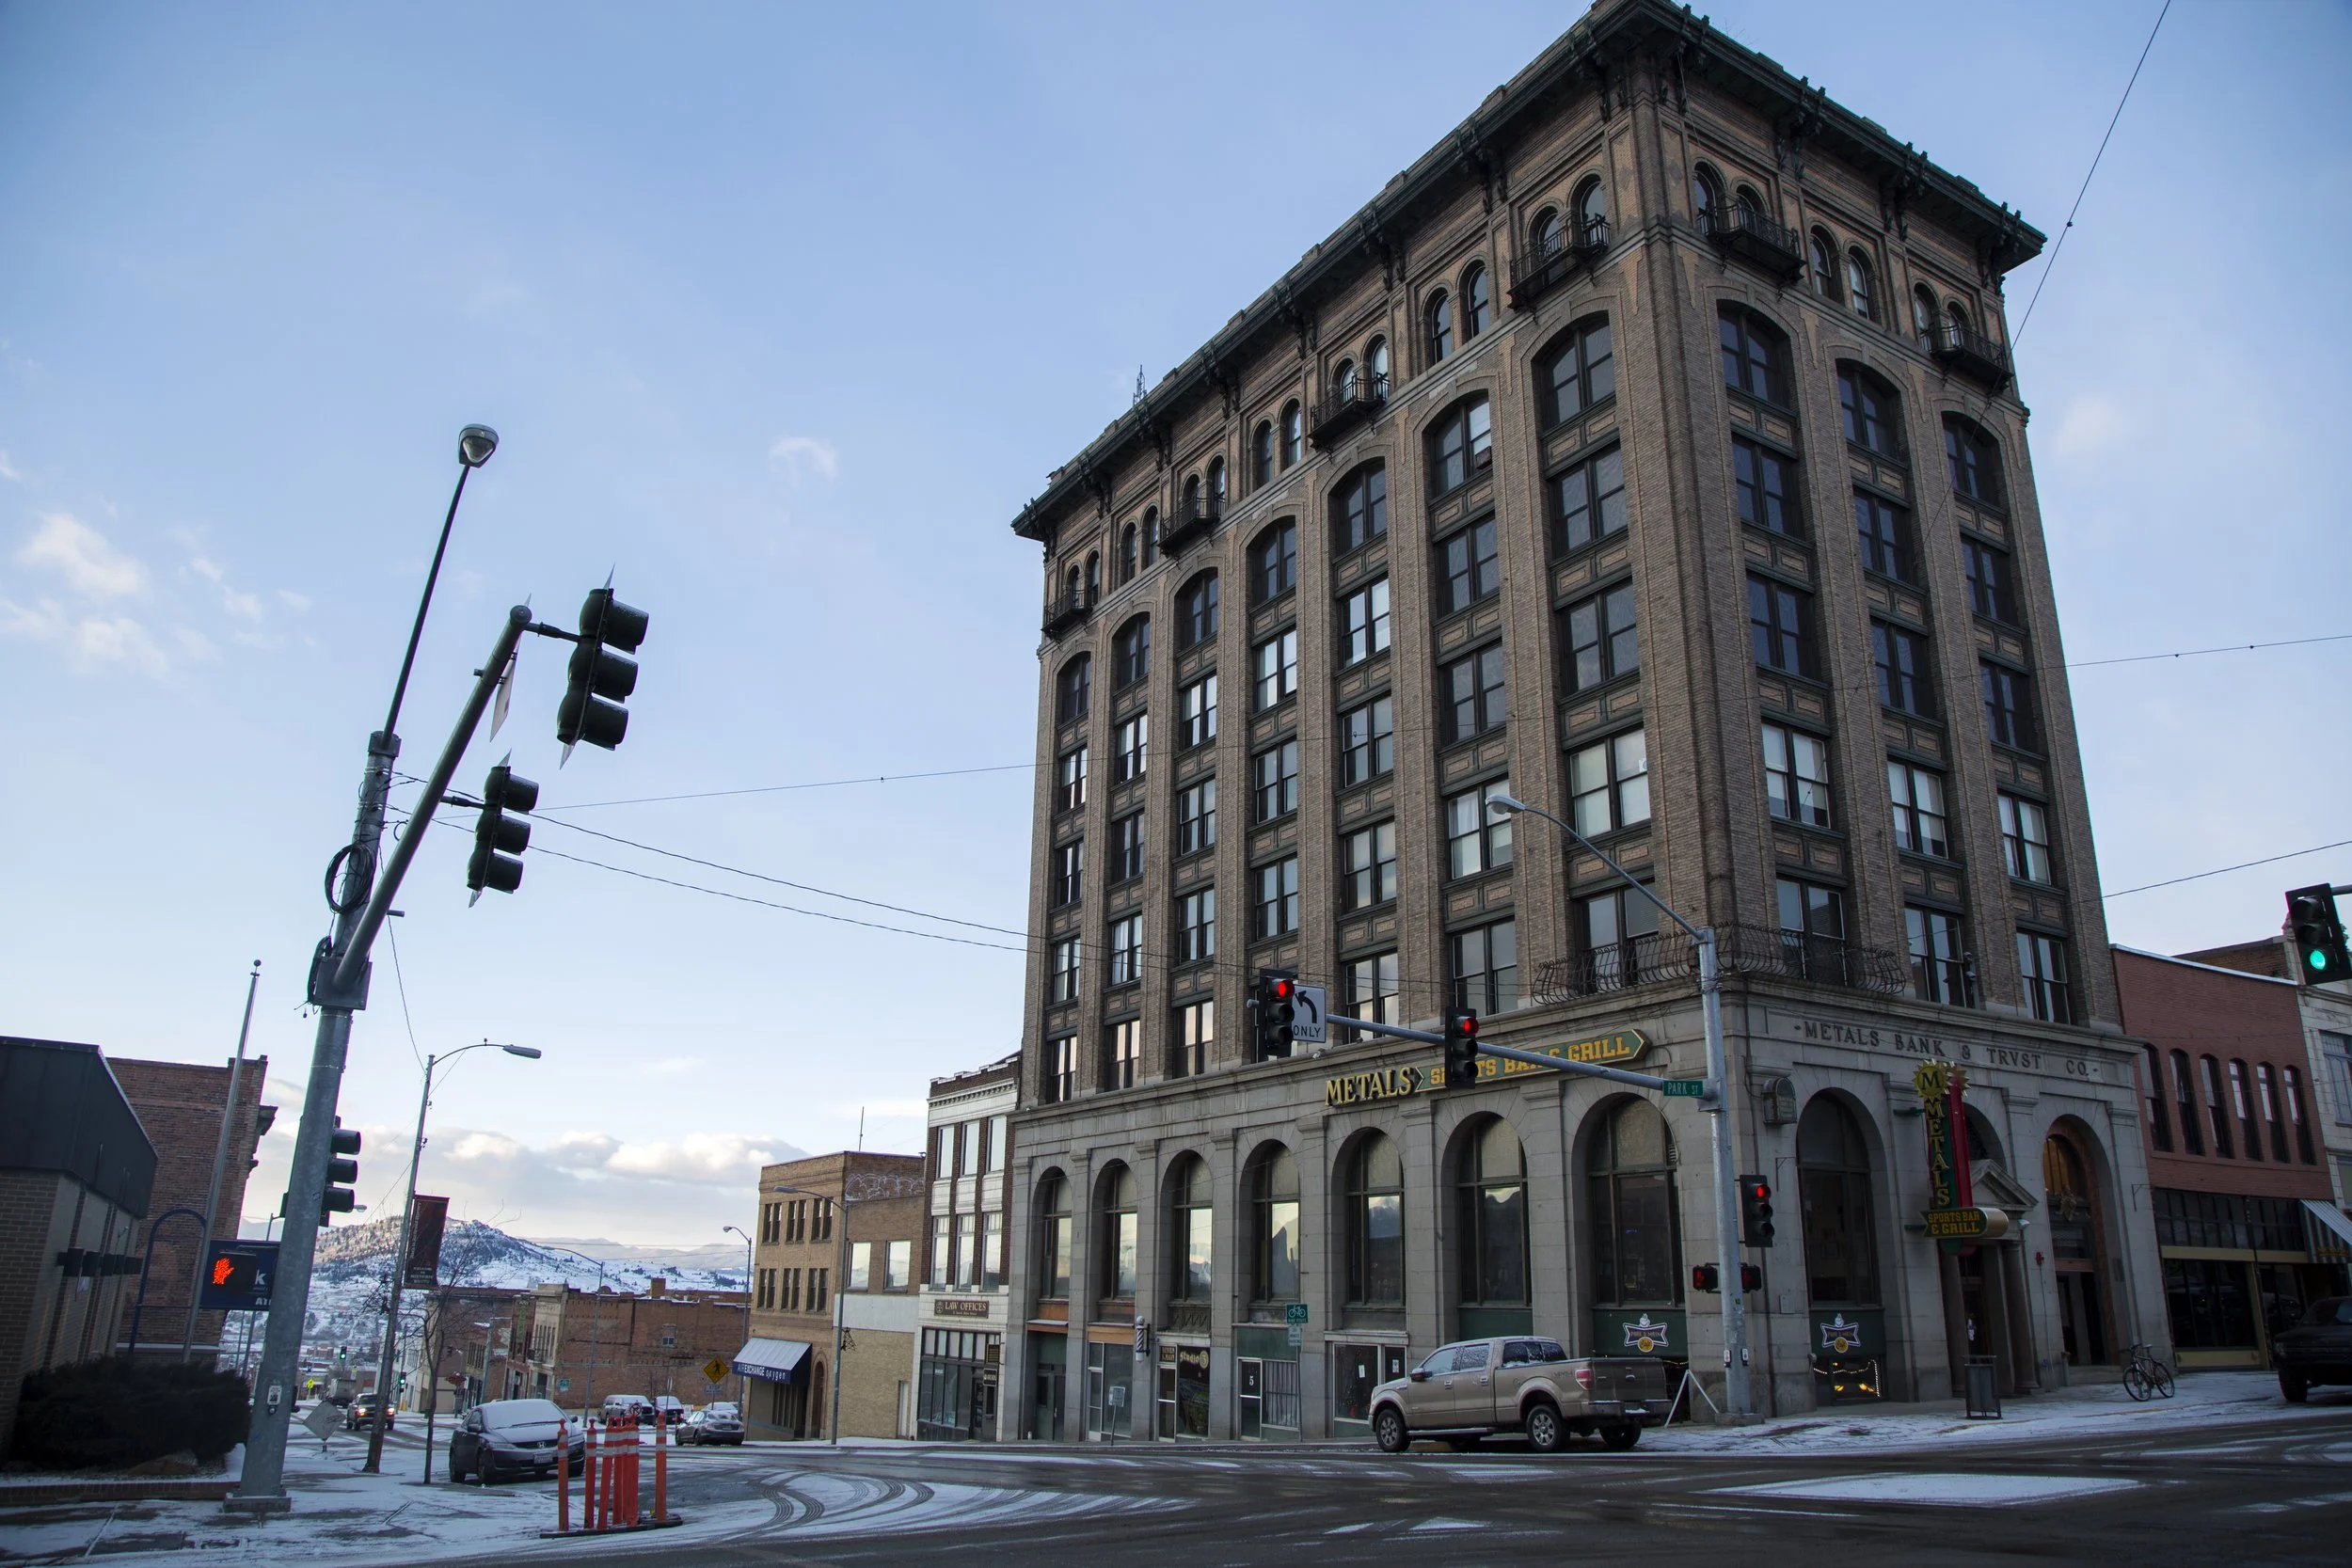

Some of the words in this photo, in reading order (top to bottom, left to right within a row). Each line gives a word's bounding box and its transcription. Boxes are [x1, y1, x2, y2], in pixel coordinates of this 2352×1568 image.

[1293, 1024, 1321, 1037] ONLY
[1804, 1021, 1880, 1047] METALS
[1894, 1034, 1946, 1056] BANK
[1567, 1037, 1630, 1061] GRILL
[1325, 1067, 1412, 1106] METALS
[1921, 1072, 1939, 1091] M
[1667, 1083, 1687, 1095] PARK
[1692, 1085, 1699, 1095] ST
[1925, 1099, 1950, 1206] METALS
[1929, 1212, 1962, 1223] SPORTS
[1963, 1211, 1979, 1221] BAR
[1942, 1222, 1979, 1233] GRILL
[945, 1301, 959, 1310] LAW
[960, 1302, 987, 1312] OFFICES
[1179, 1351, 1200, 1364] Studio
[1248, 1375, 1254, 1386] 5
